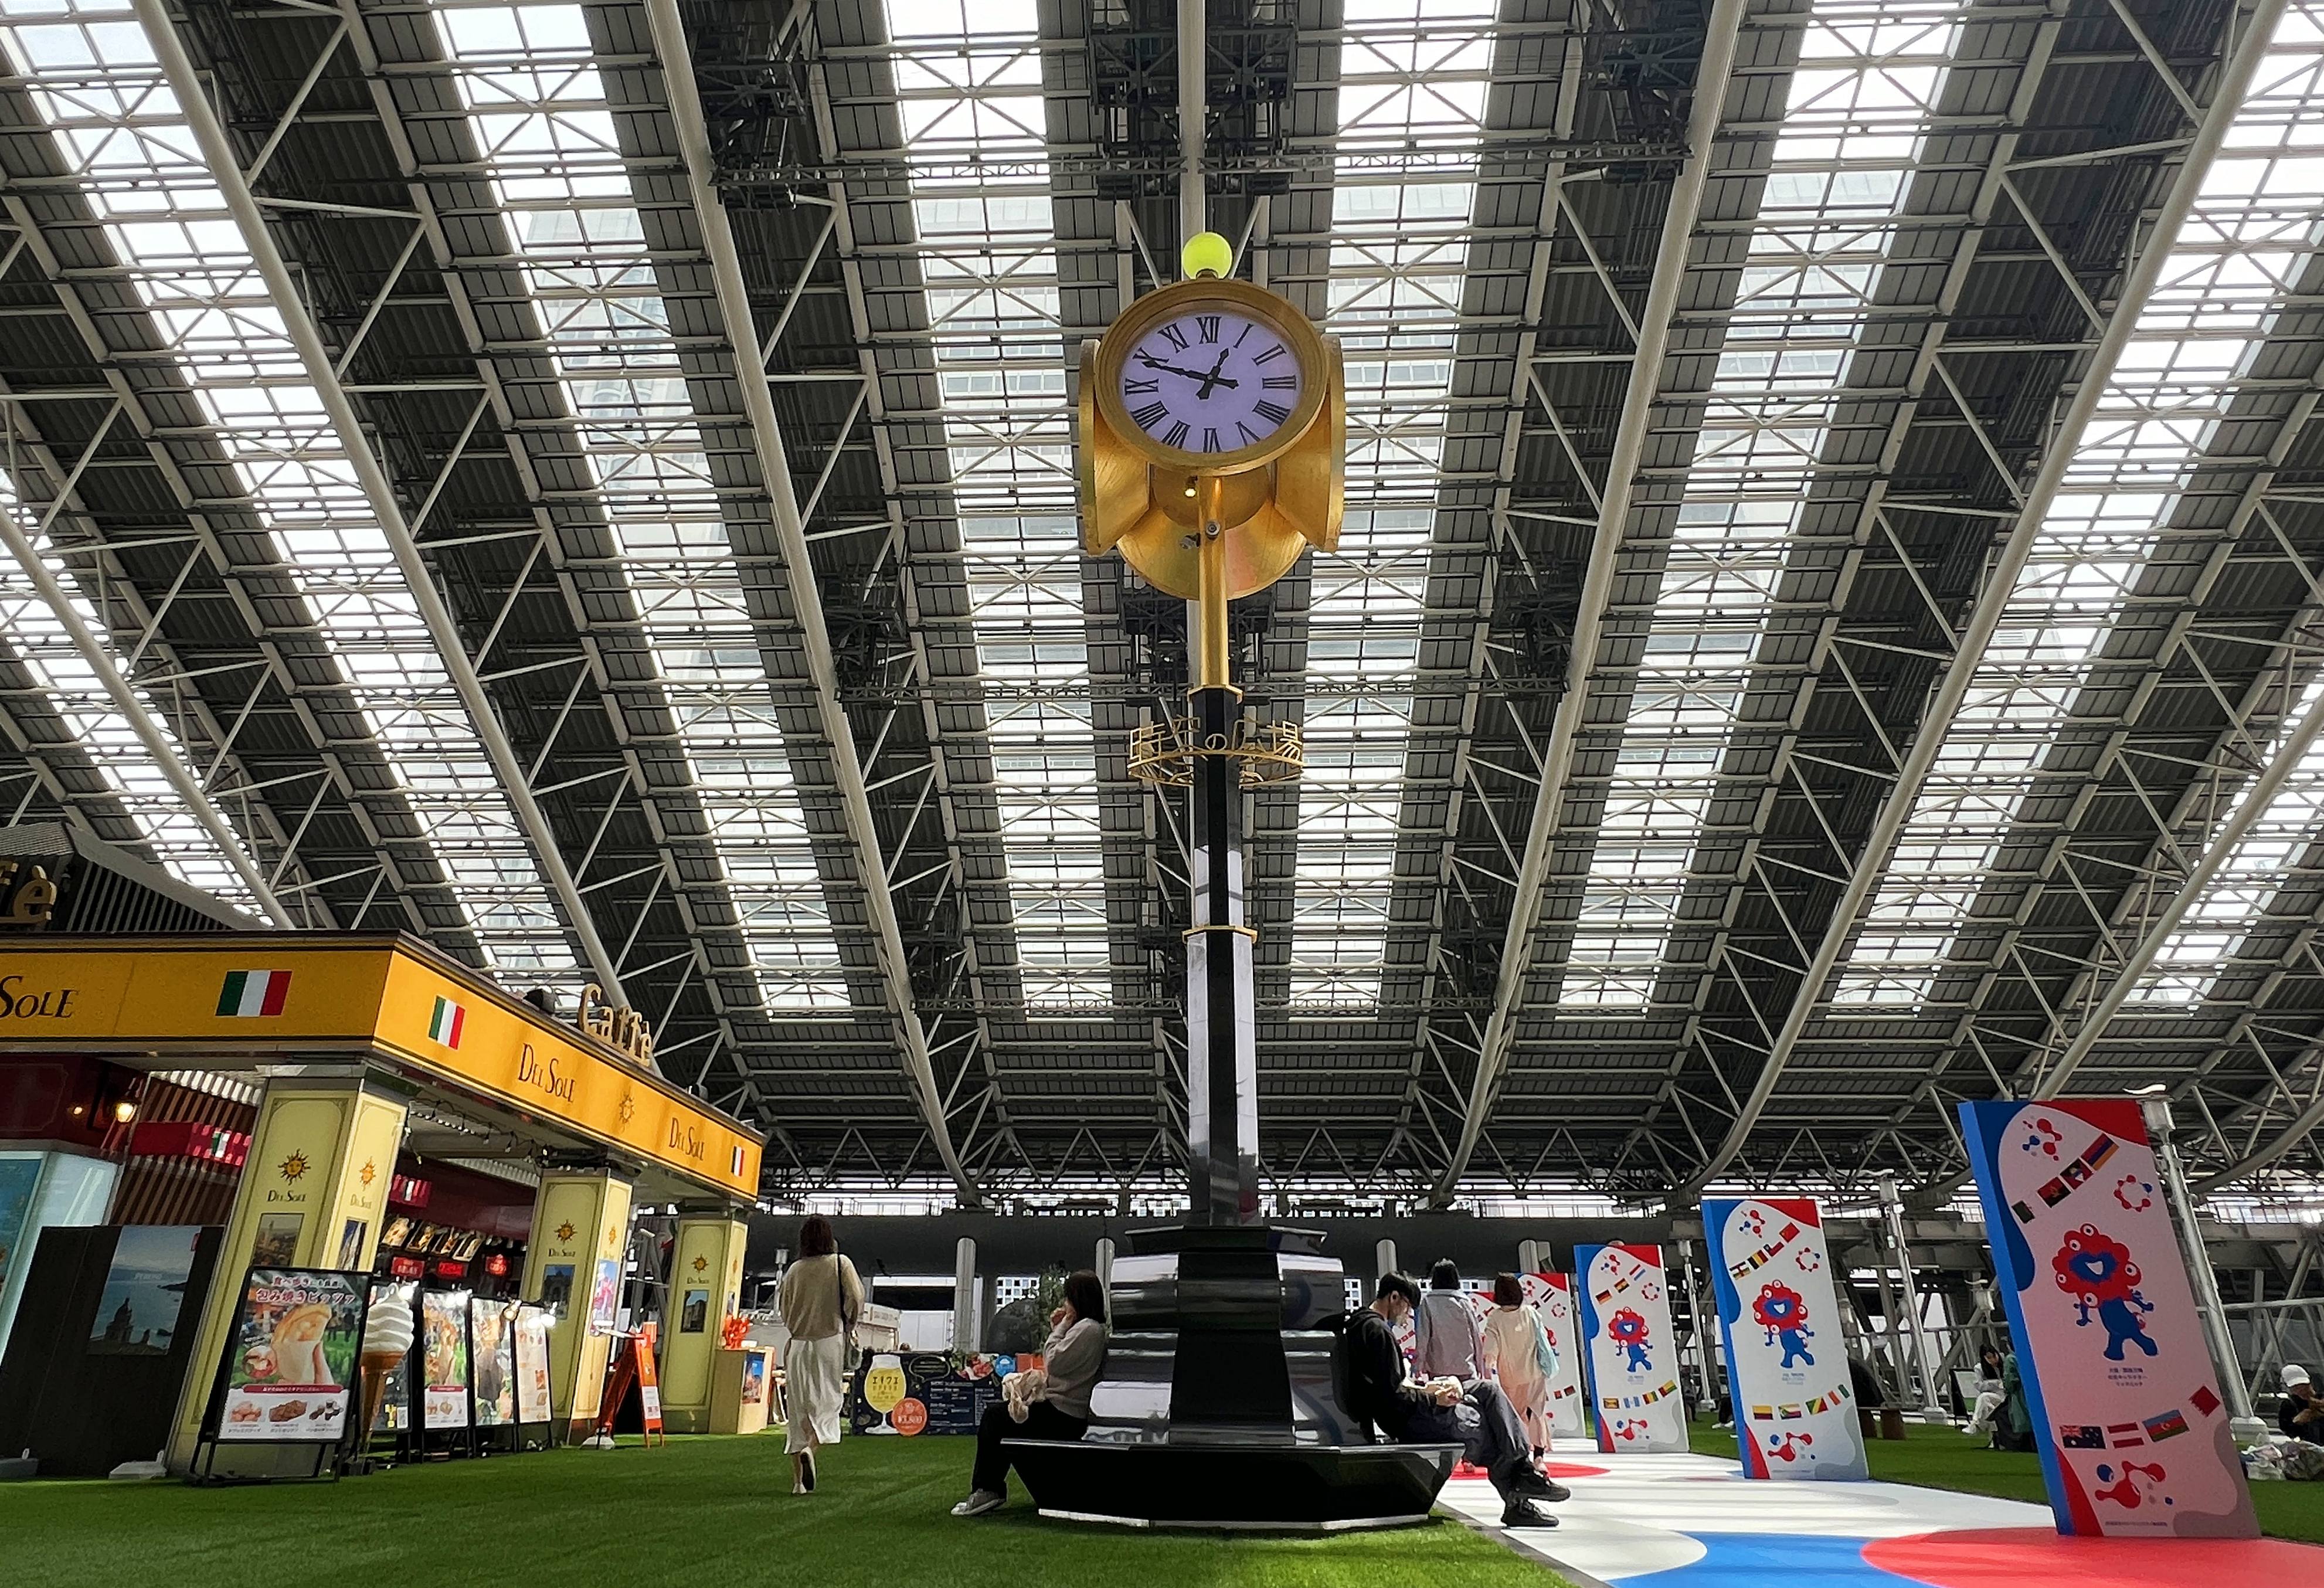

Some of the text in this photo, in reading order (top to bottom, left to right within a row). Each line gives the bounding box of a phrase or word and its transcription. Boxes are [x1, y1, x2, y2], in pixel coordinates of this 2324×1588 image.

[1157, 323, 1190, 353] XI
[1195, 316, 1221, 344] XII
[1233, 324, 1253, 348] I
[1252, 343, 1286, 366] II
[1124, 378, 1159, 396] IX
[1262, 375, 1296, 391] III
[1130, 401, 1170, 432] VIII
[1161, 419, 1191, 449] VII
